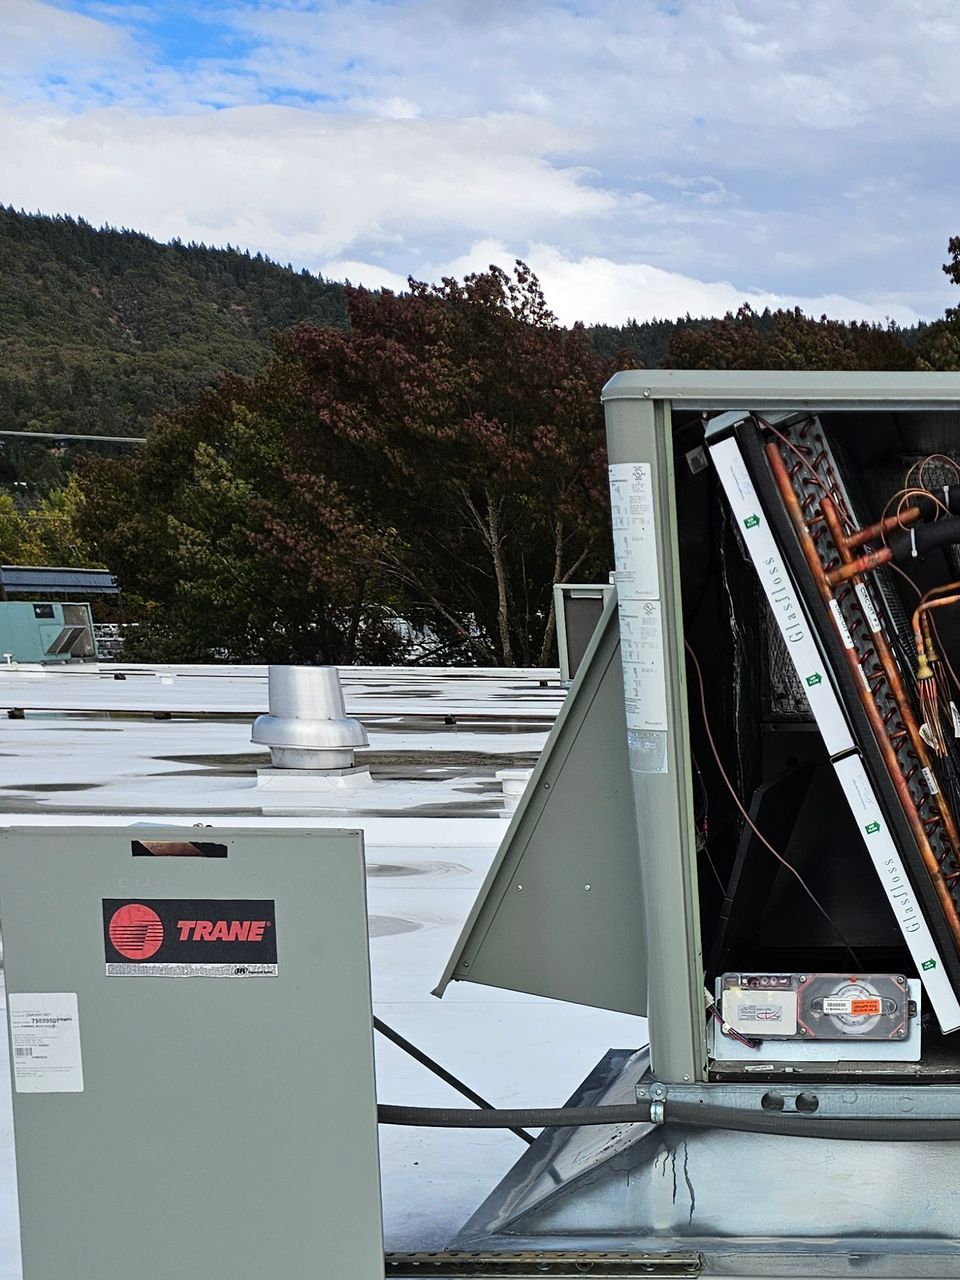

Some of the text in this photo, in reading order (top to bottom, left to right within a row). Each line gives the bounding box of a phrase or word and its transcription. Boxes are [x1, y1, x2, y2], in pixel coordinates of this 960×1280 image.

[766, 557, 805, 642] Glasfloss
[176, 920, 266, 942] TRANE
[884, 858, 921, 933] Glasfloss
